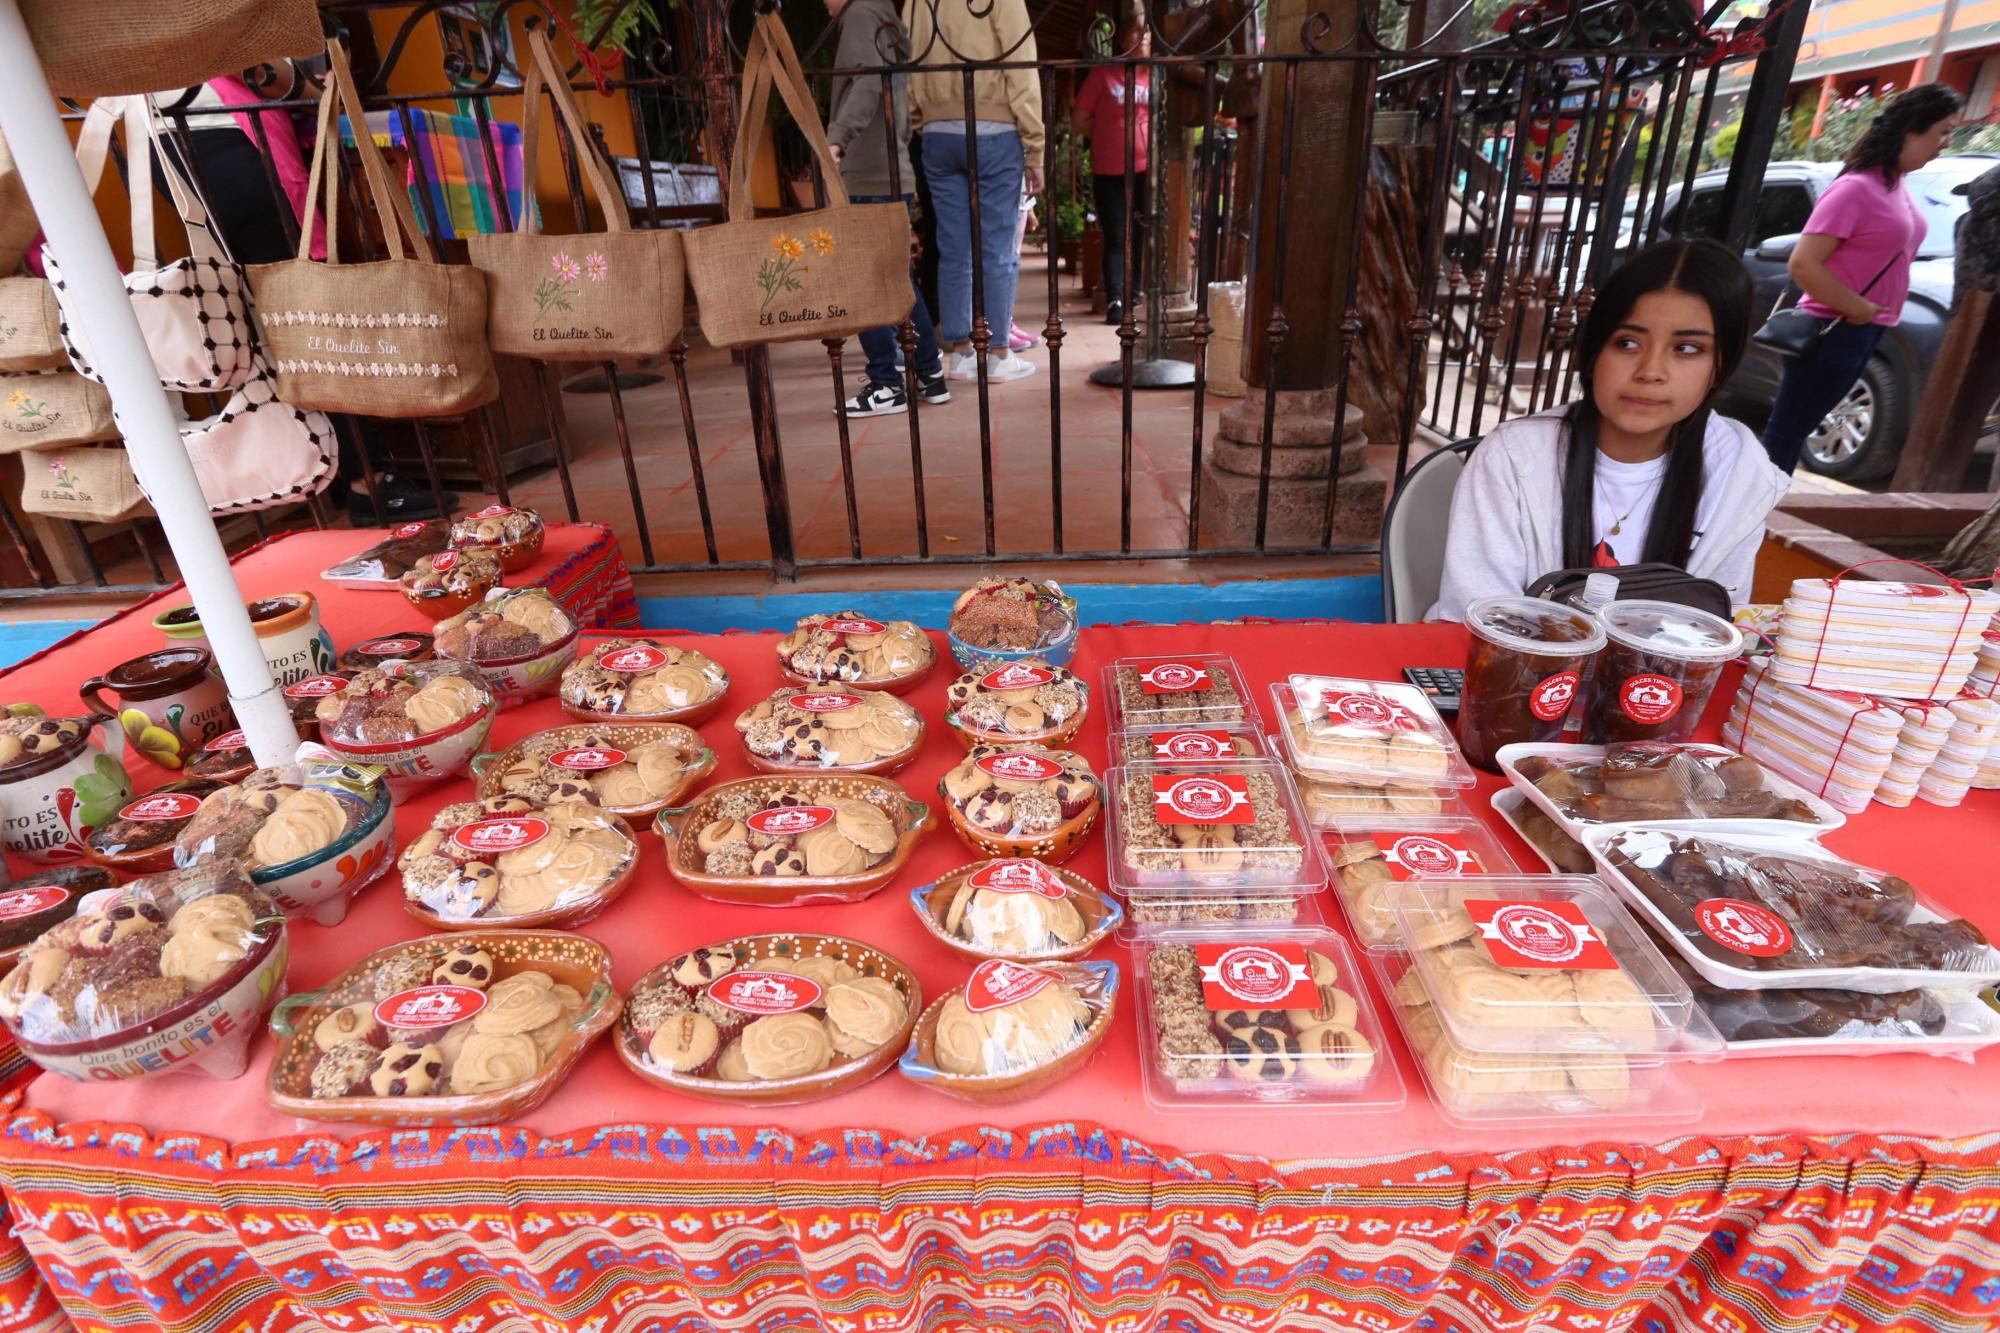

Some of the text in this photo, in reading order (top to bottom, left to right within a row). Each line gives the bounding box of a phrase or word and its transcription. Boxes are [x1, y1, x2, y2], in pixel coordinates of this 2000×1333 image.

[760, 305, 848, 325] El Quelite Sin
[533, 326, 615, 340] El Quelite Sin
[307, 336, 400, 355] El Quelite Sin
[292, 650, 307, 663] ES
[274, 667, 312, 689] elite
[1629, 678, 1652, 688] DULCES
[190, 706, 217, 726] QUE
[365, 753, 395, 763] bonito
[386, 754, 434, 778] LITE
[37, 807, 58, 824] ES
[5, 830, 70, 851] elite
[1714, 930, 1750, 950] DULCES
[79, 1000, 223, 1066] Que bonito es el
[88, 1011, 237, 1082] QUELITE
